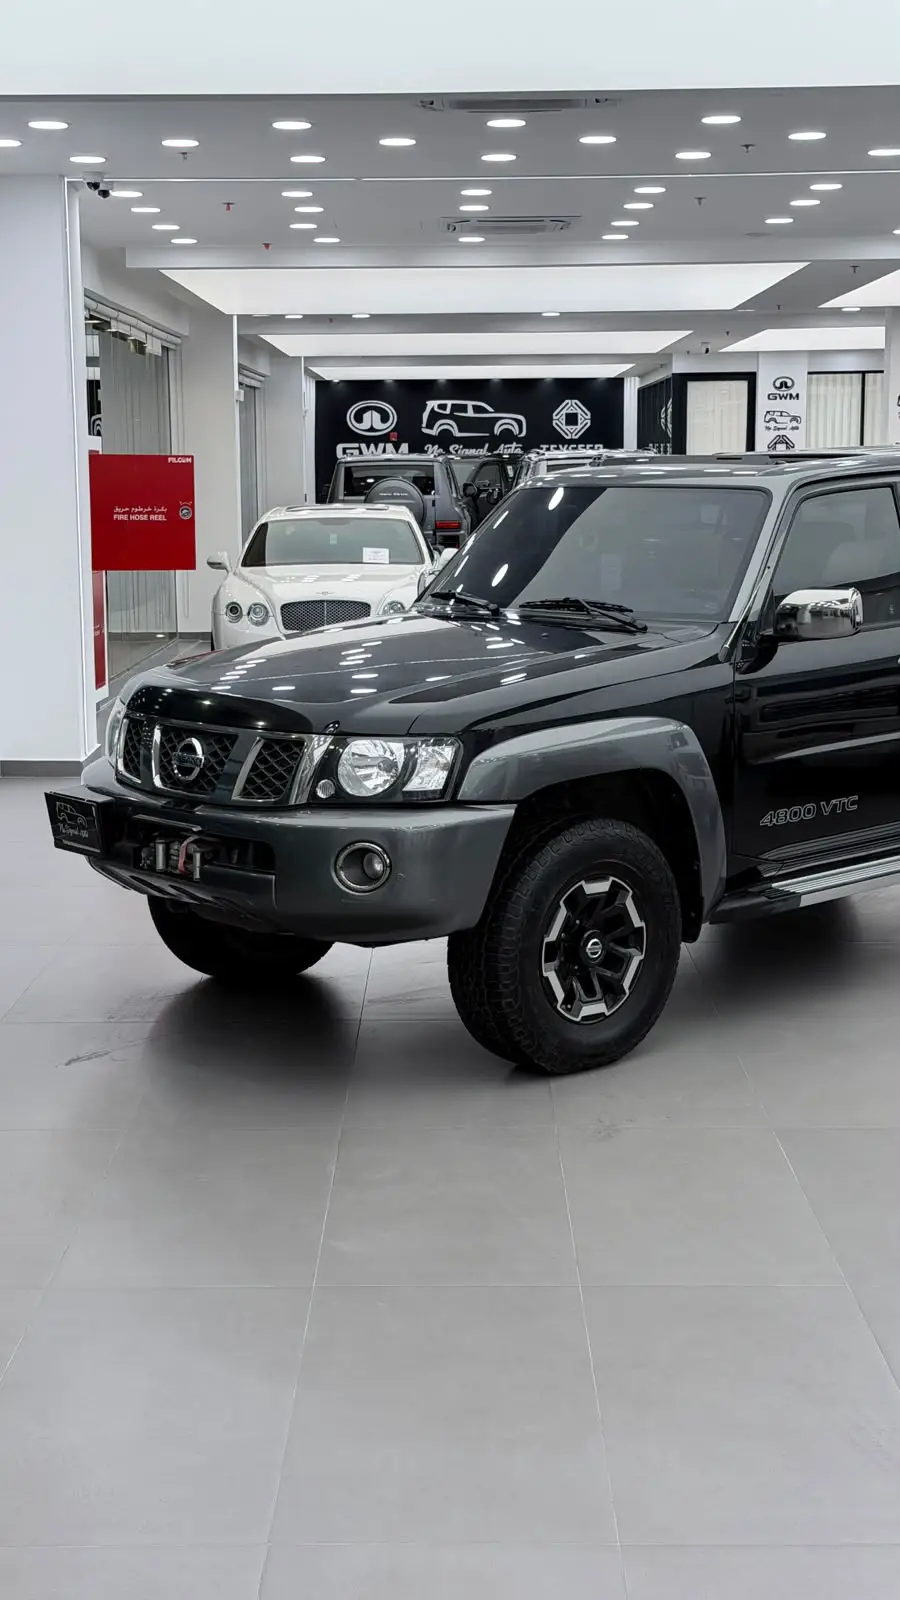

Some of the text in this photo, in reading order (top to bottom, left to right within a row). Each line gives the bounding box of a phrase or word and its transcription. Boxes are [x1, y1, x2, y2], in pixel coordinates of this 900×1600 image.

[336, 443, 408, 458] GWM
[424, 444, 446, 455] No
[493, 442, 523, 454] Auto
[760, 795, 859, 826] 4800 VTC
